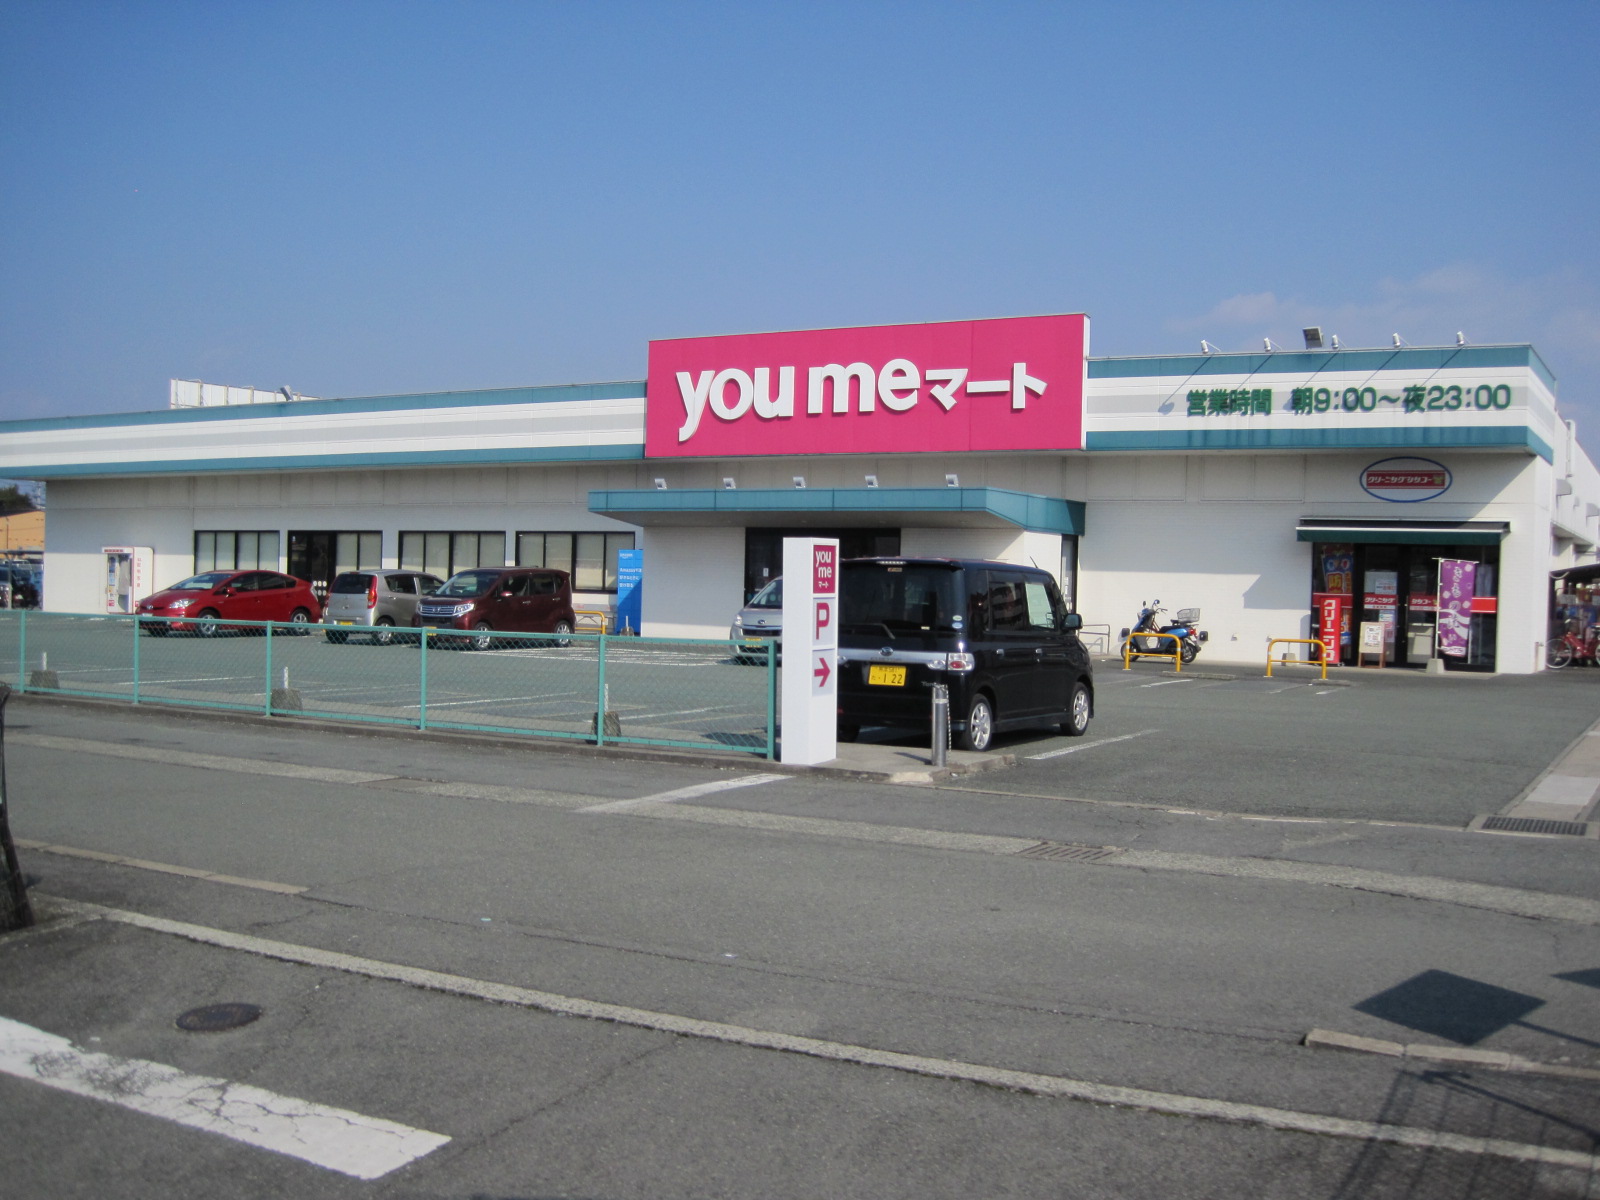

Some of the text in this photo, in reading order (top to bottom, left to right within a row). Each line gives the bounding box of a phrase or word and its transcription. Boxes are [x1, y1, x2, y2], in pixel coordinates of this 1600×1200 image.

[675, 366, 795, 442] you
[925, 362, 1048, 411] マート
[1186, 388, 1272, 417] 営業時間
[815, 551, 832, 567] you
[818, 566, 832, 578] me
[816, 602, 830, 640] P
